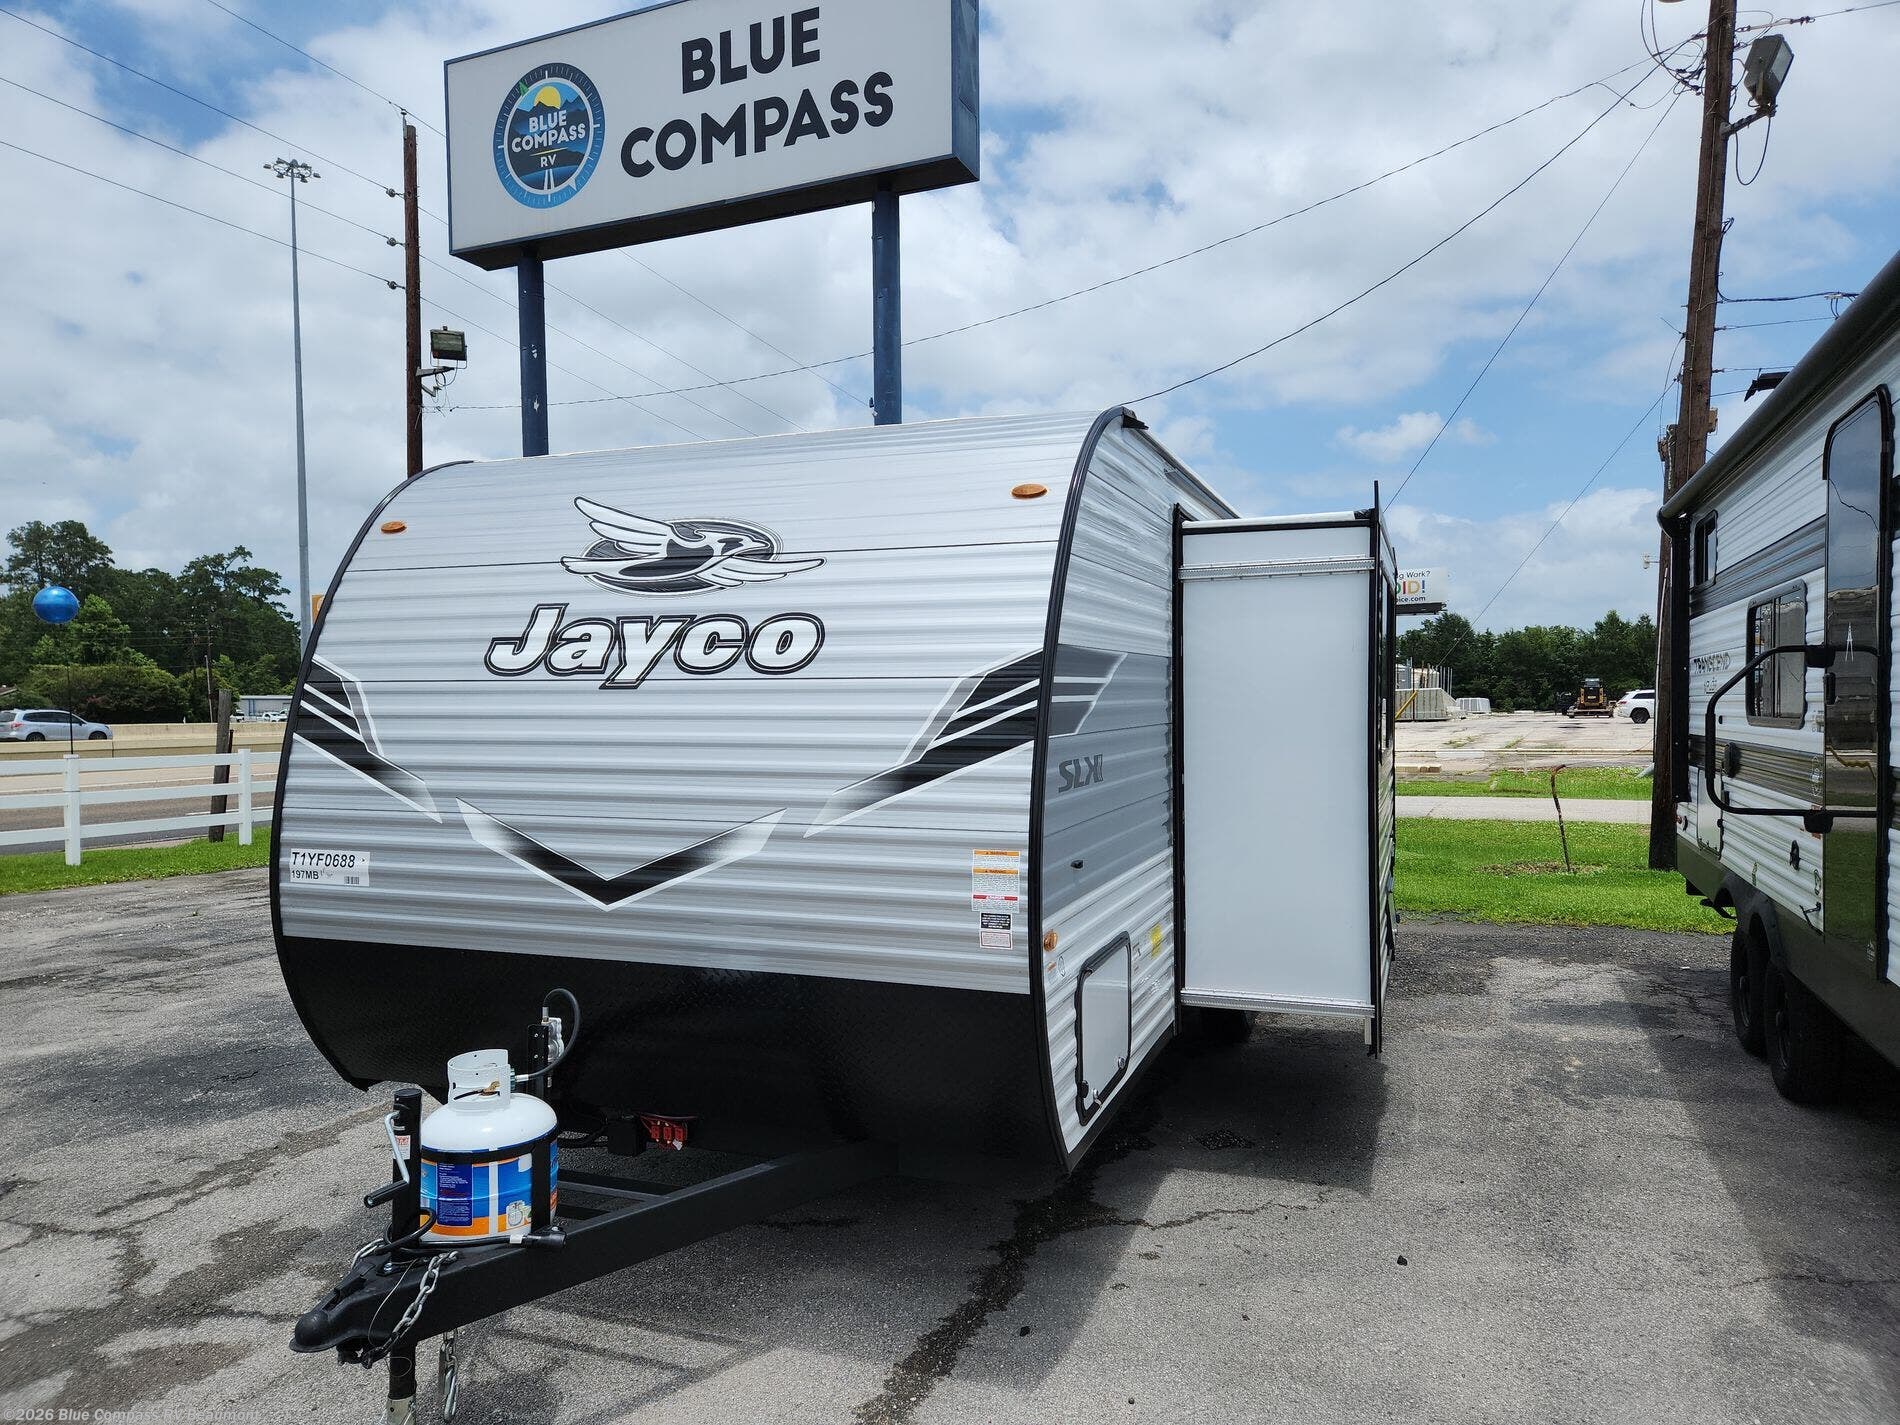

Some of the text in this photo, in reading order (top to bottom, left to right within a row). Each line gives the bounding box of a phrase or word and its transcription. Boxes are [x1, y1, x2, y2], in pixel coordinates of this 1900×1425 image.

[681, 6, 821, 94] BLUE
[528, 110, 567, 133] BLUE
[620, 71, 894, 178] COMPASS
[511, 123, 586, 153] COMPASS
[540, 154, 557, 168] RV
[1406, 570, 1431, 578] Work?
[484, 603, 826, 690] Jayco
[291, 851, 356, 869] T1YF0688
[291, 869, 320, 880] 197MB
